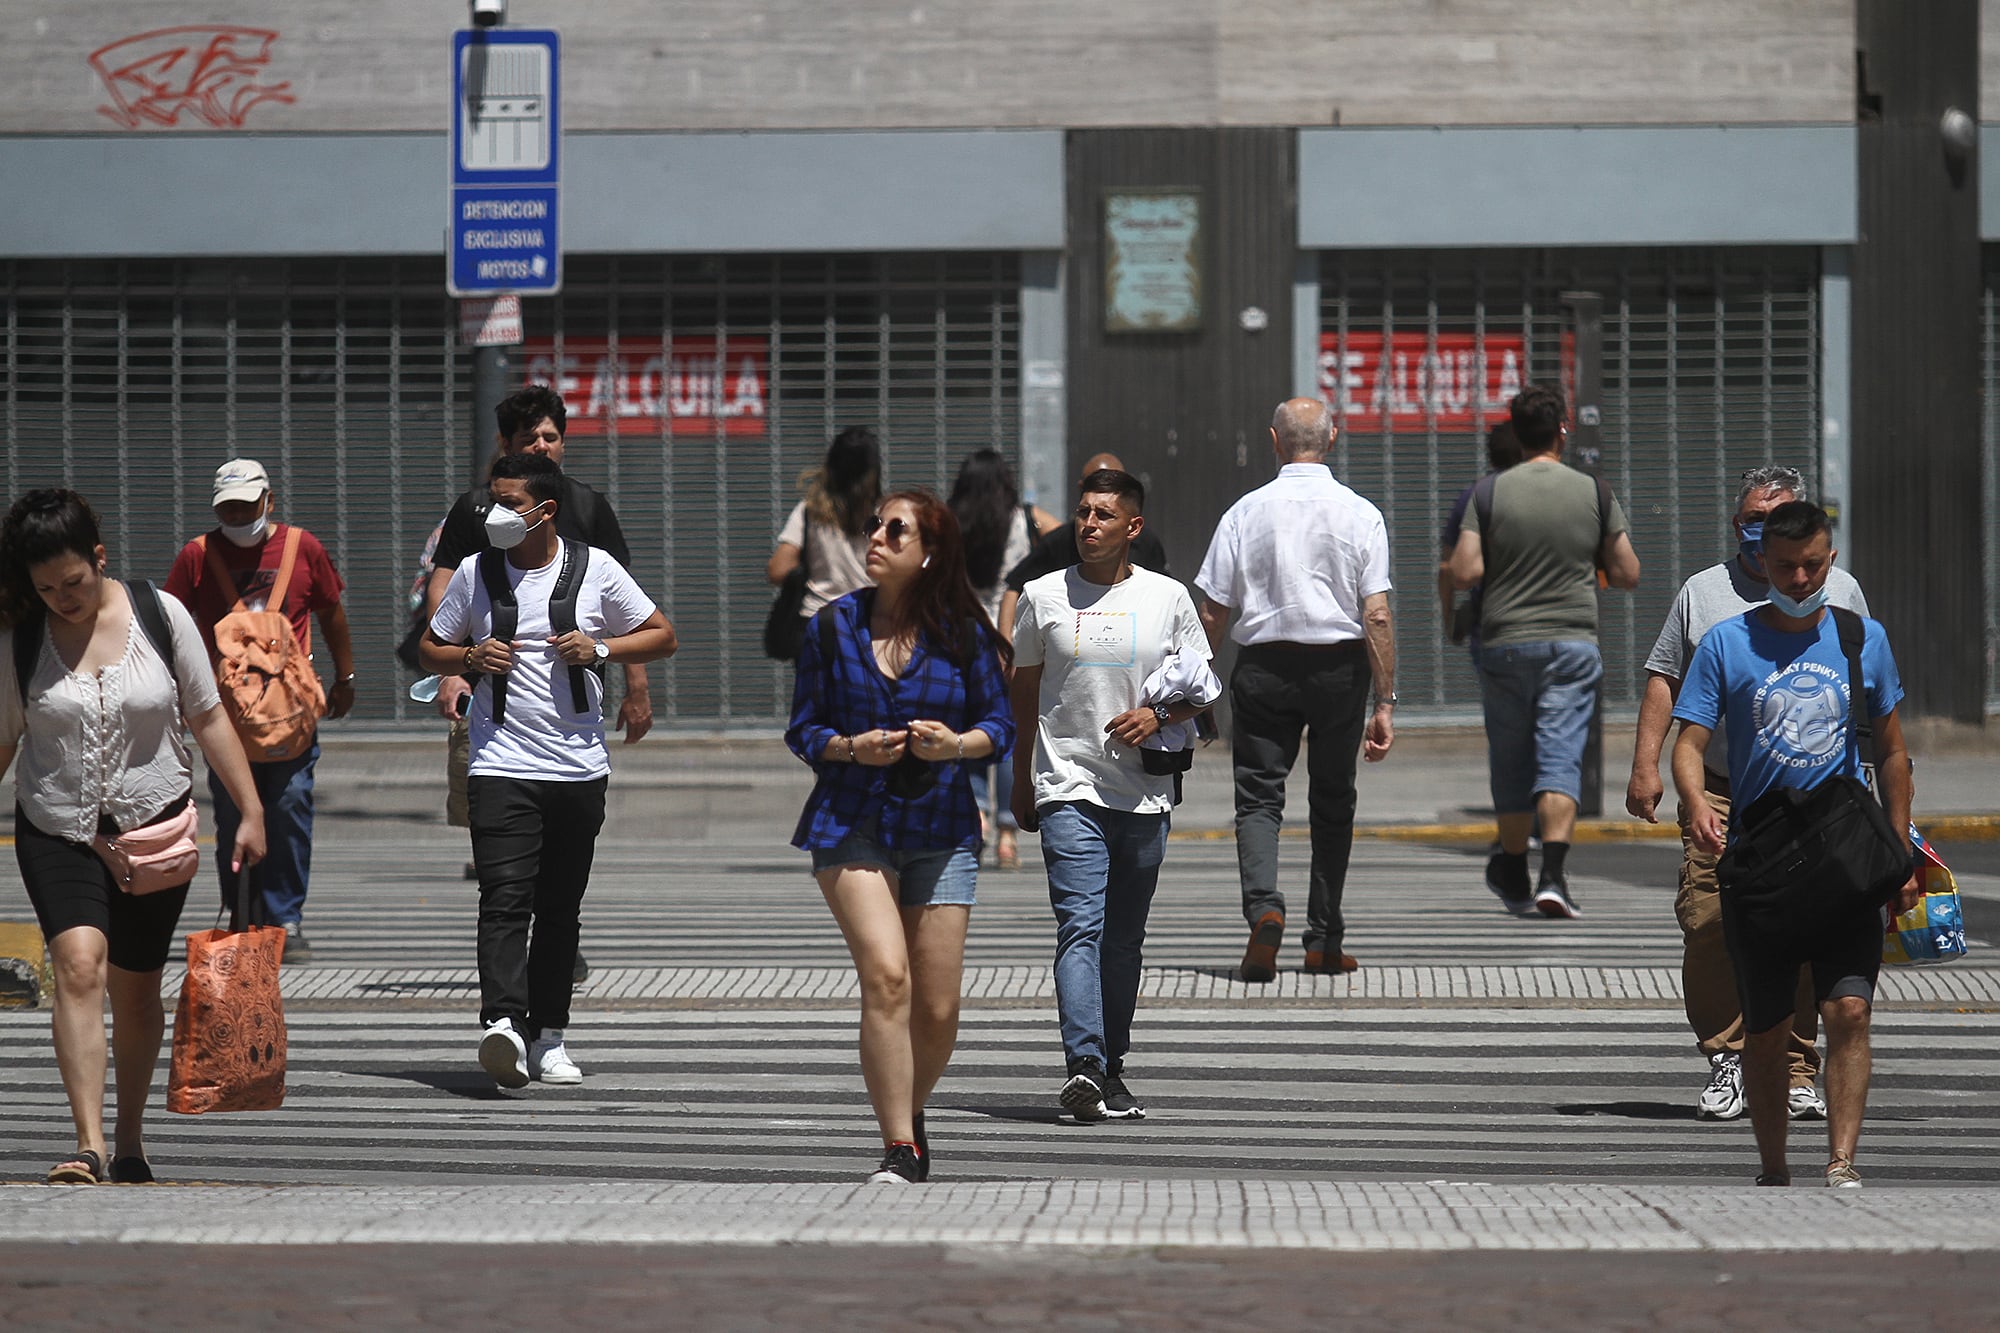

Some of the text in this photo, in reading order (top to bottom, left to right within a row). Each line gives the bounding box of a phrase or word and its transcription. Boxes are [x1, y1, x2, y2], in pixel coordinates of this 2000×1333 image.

[462, 200, 547, 220] DETENCION
[463, 230, 545, 249] EXCLUSIVA
[477, 259, 530, 279] MOTOS
[587, 356, 765, 417] ALQUILA
[1319, 349, 1521, 414] SE ALQUILA
[1802, 662, 1839, 680] PENKY
[1809, 736, 1846, 768] QUALITY
